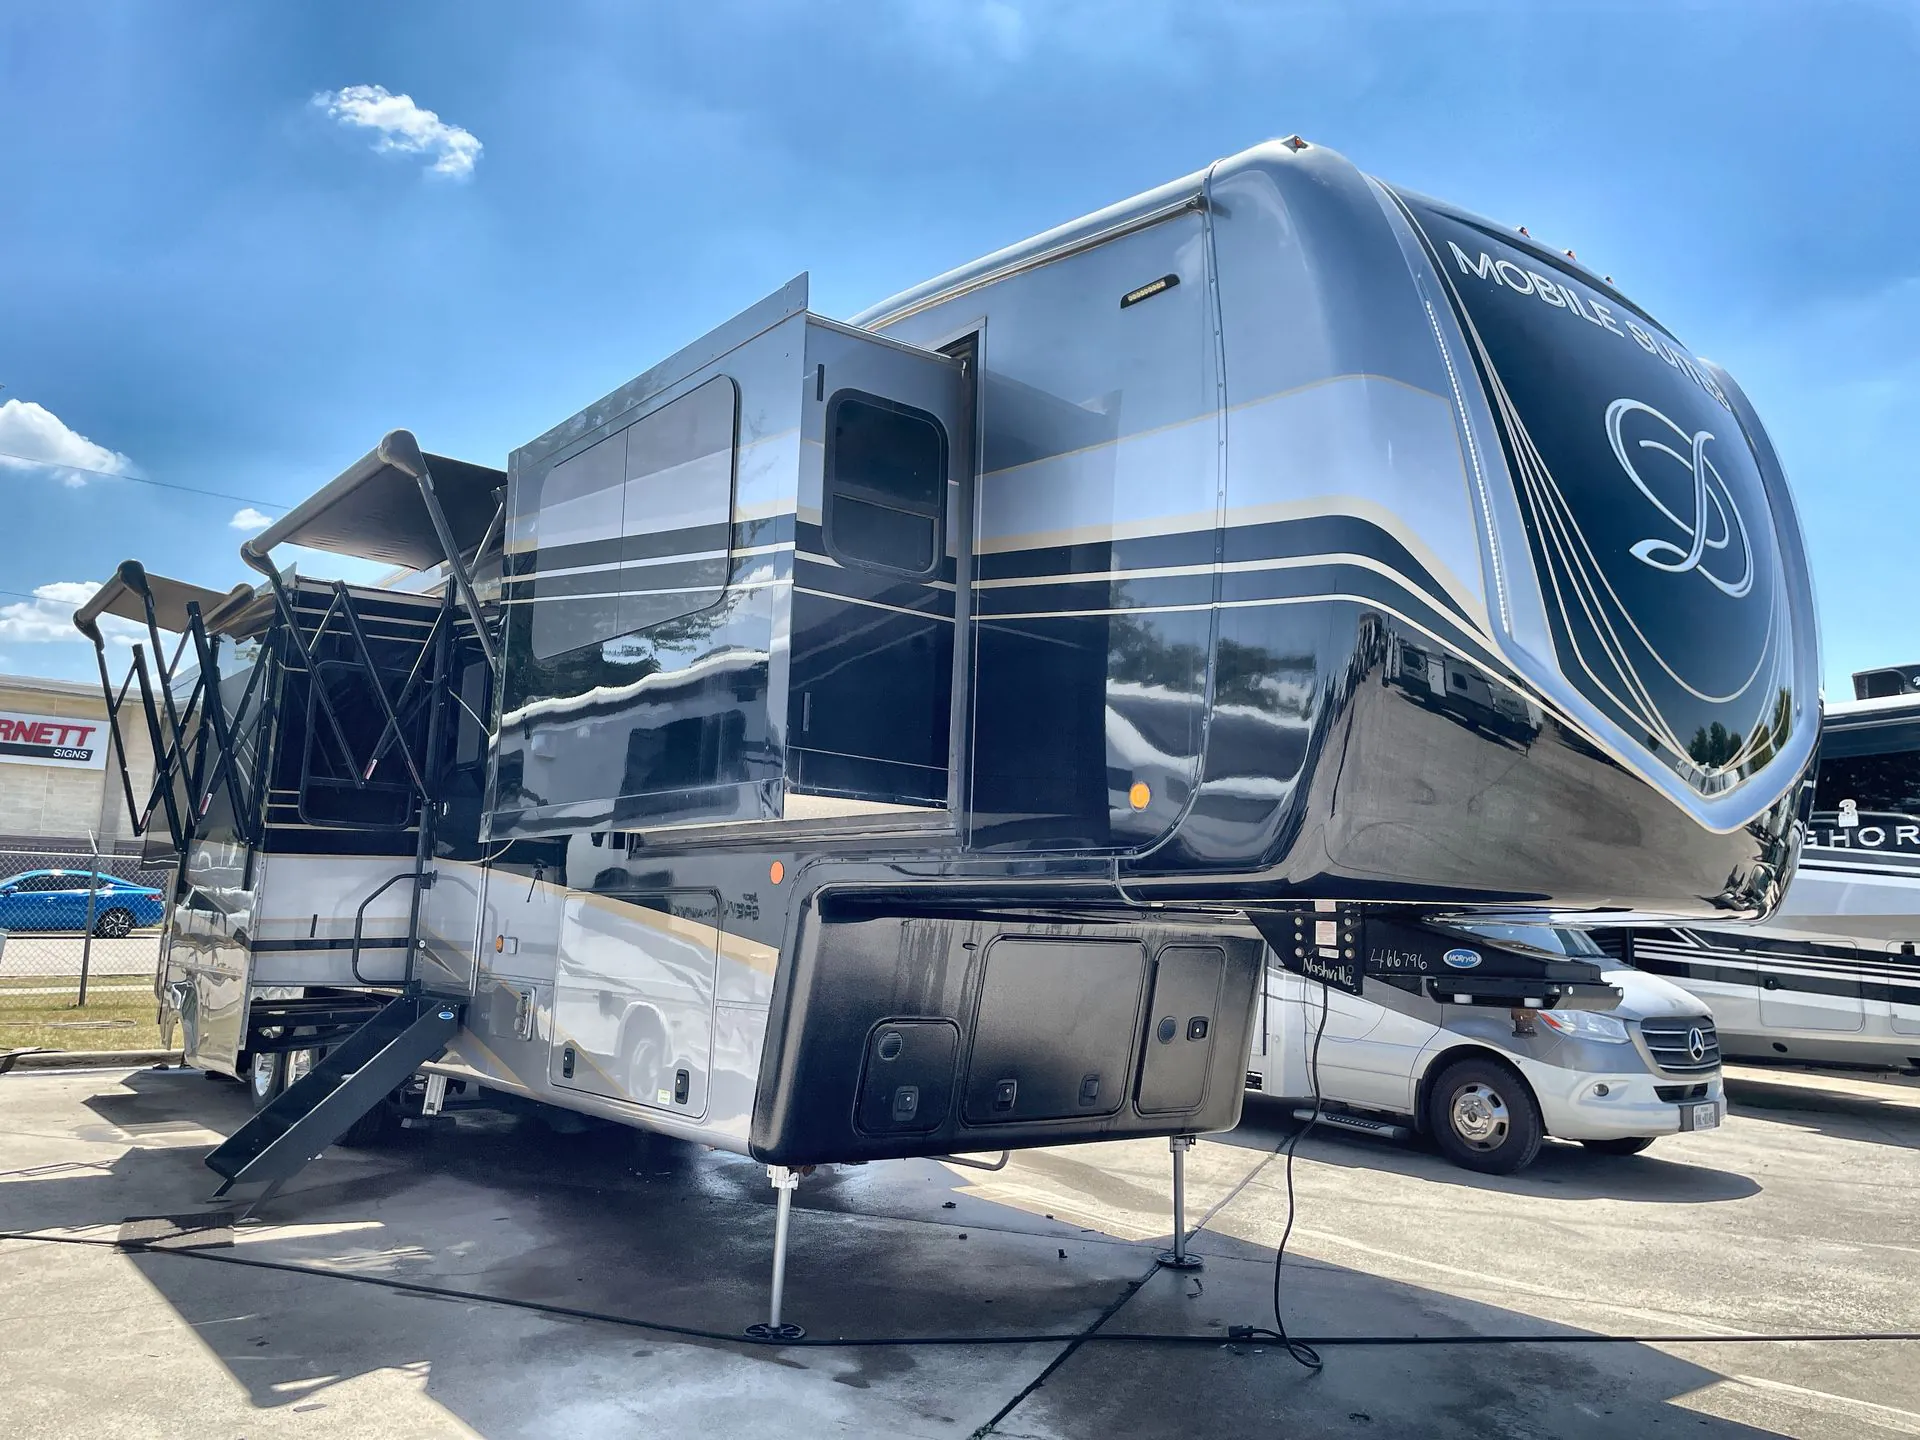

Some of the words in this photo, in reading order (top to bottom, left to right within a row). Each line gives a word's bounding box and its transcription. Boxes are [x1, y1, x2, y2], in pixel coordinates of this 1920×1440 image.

[1447, 241, 1625, 337] MOBILE
[0, 719, 97, 747] RNETT
[53, 748, 88, 759] SIGNS
[1302, 957, 1355, 986] Nashville
[1370, 948, 1428, 970] 466796
